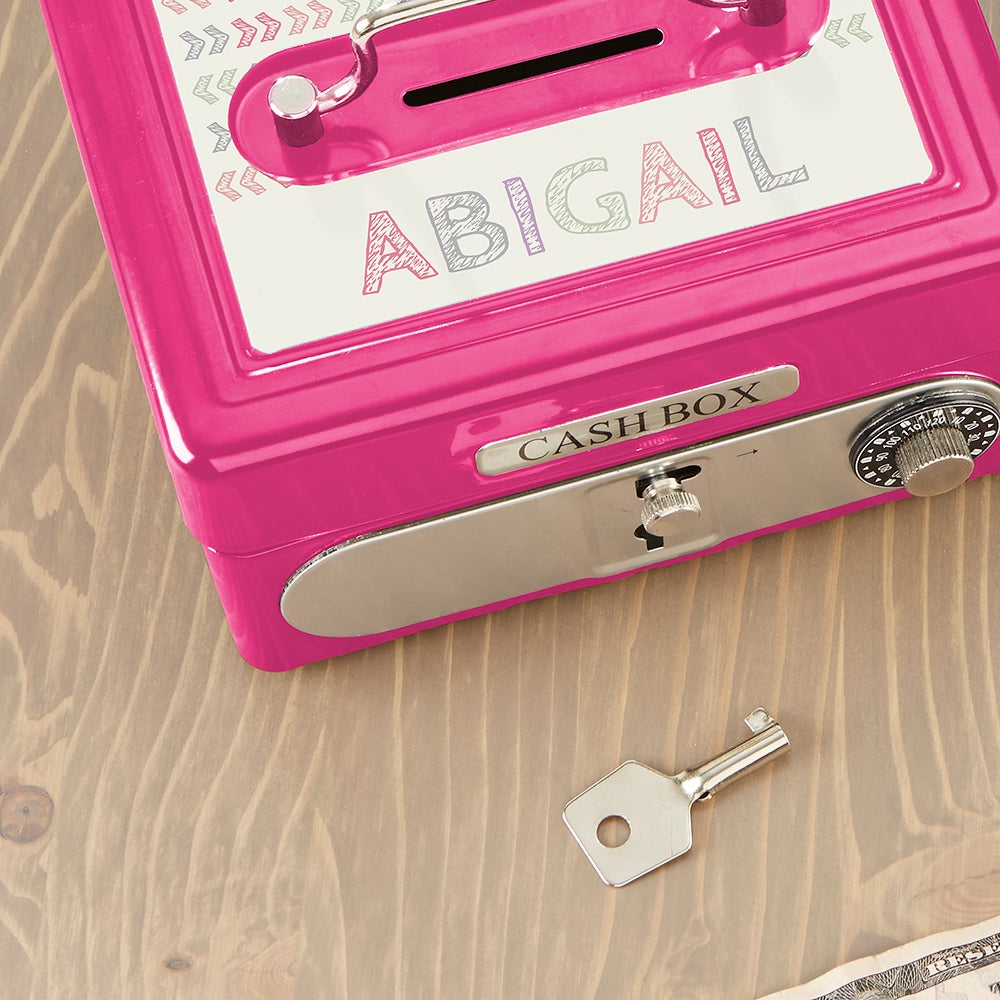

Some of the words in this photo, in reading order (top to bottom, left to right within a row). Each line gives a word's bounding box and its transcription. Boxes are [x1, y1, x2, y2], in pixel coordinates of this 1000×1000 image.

[362, 116, 809, 295] ABIGAIL
[518, 411, 647, 462] CASH
[662, 381, 762, 426] BOX
[883, 436, 901, 449] 100
[902, 423, 922, 436] 110
[926, 417, 945, 428] 120
